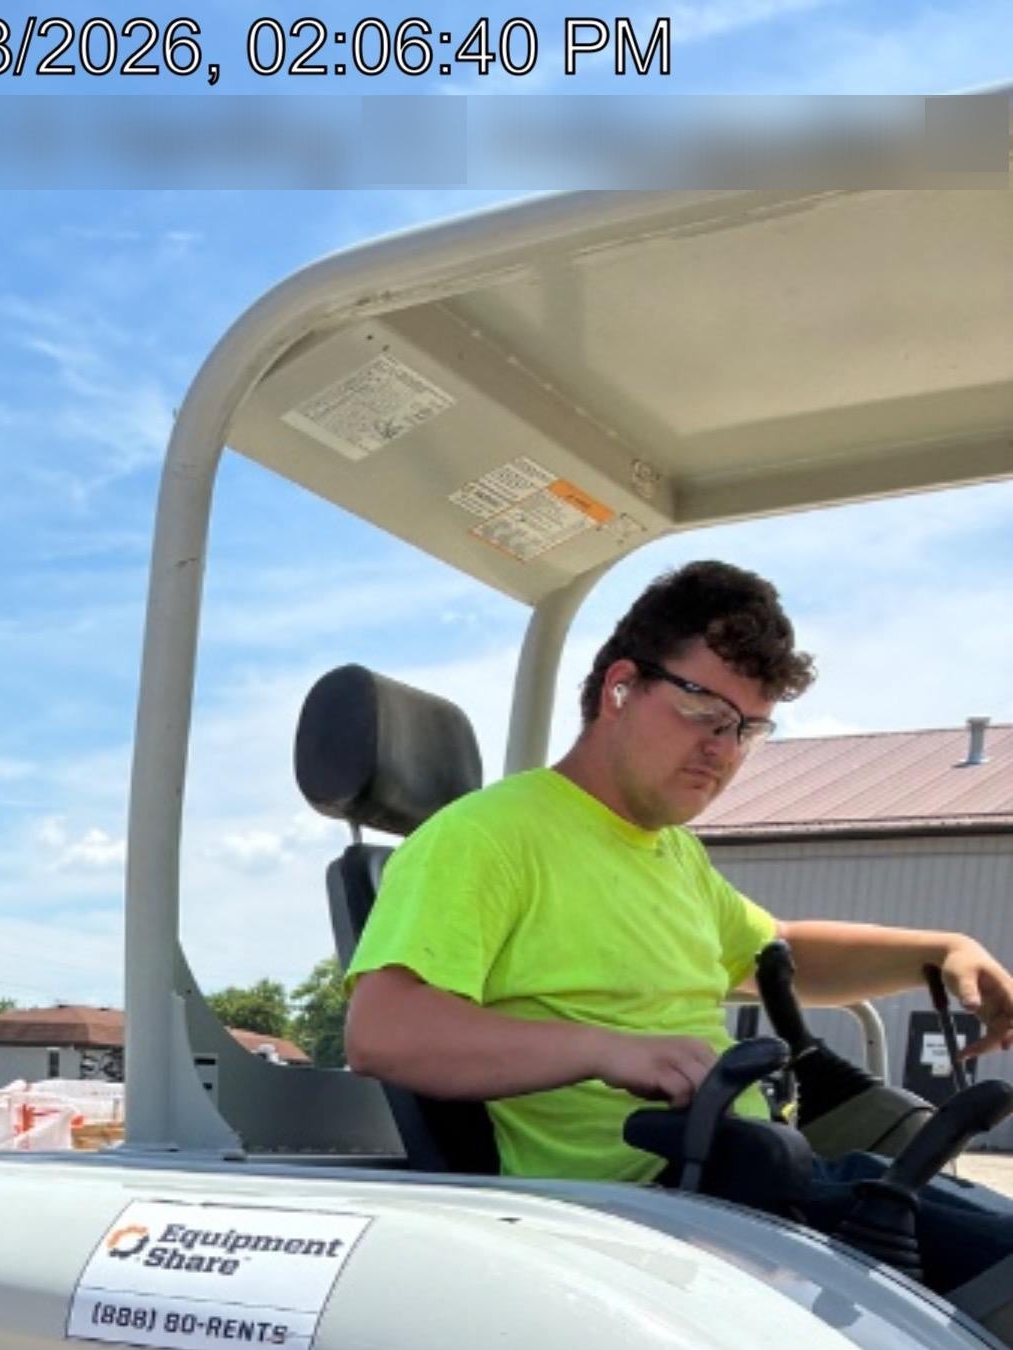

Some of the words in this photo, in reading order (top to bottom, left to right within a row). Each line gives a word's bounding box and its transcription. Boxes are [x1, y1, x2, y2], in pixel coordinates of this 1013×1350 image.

[157, 1222, 344, 1258] Equipment
[143, 1246, 240, 1276] Share
[90, 1300, 159, 1333] (888)
[162, 1311, 289, 1345] 80-RENTS
